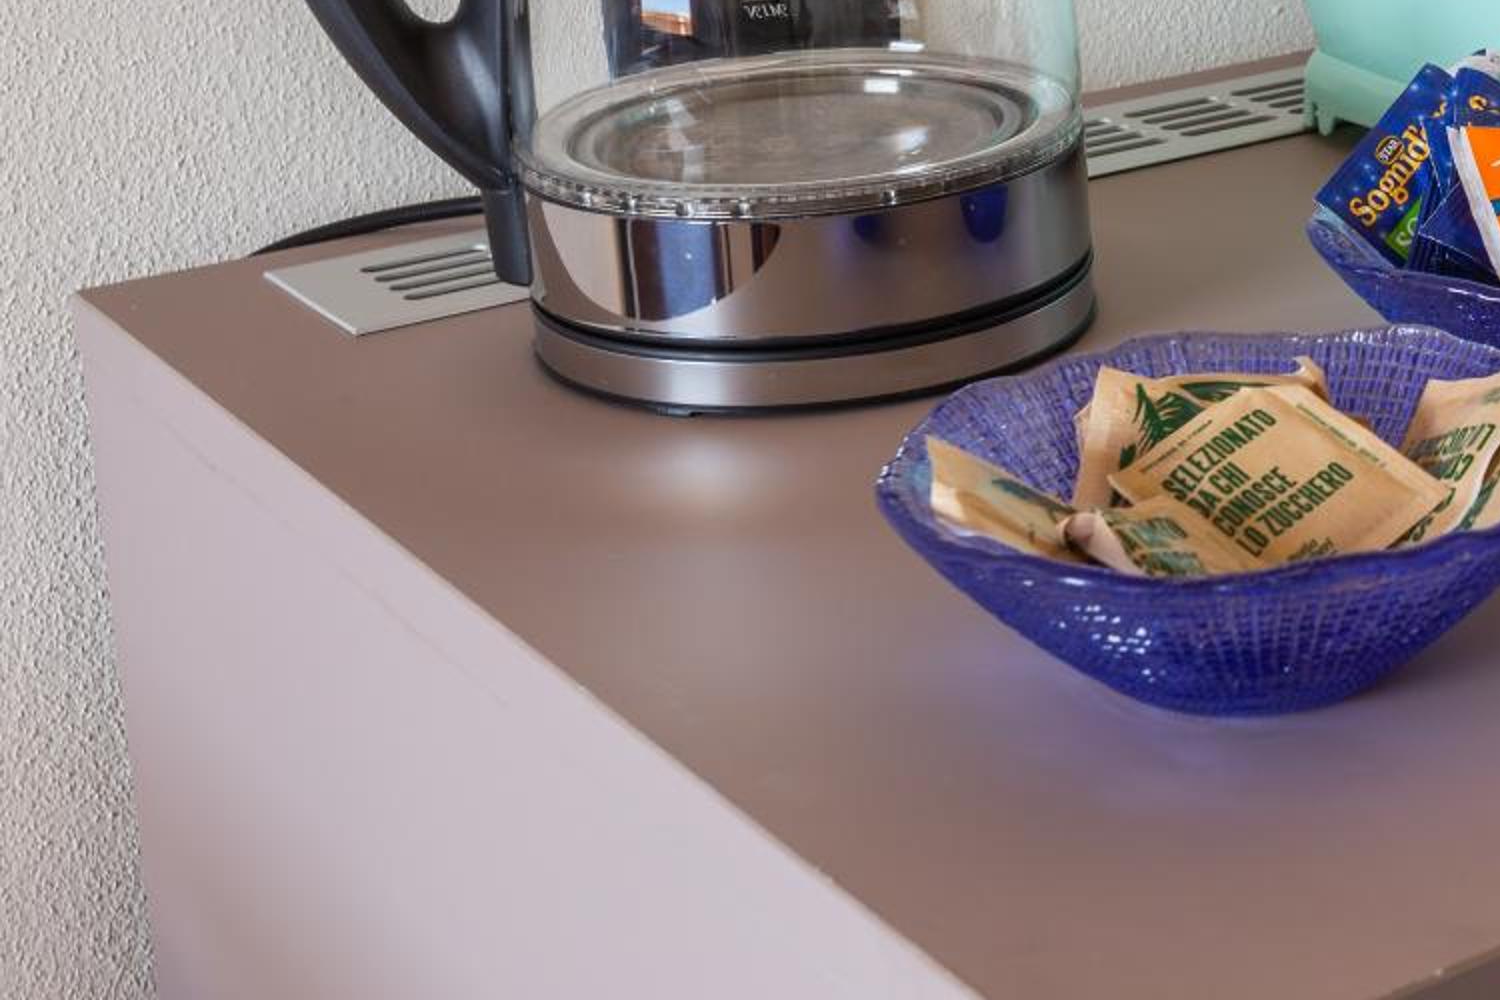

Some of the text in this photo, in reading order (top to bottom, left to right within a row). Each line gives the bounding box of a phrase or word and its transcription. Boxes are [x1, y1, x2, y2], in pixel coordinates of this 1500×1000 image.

[1161, 408, 1278, 502] SELEZIONATO
[1208, 460, 1251, 498] CHI
[1211, 465, 1298, 538] CONOSCE
[1234, 524, 1270, 559] LO
[1255, 460, 1355, 537] ZUCCHERO
